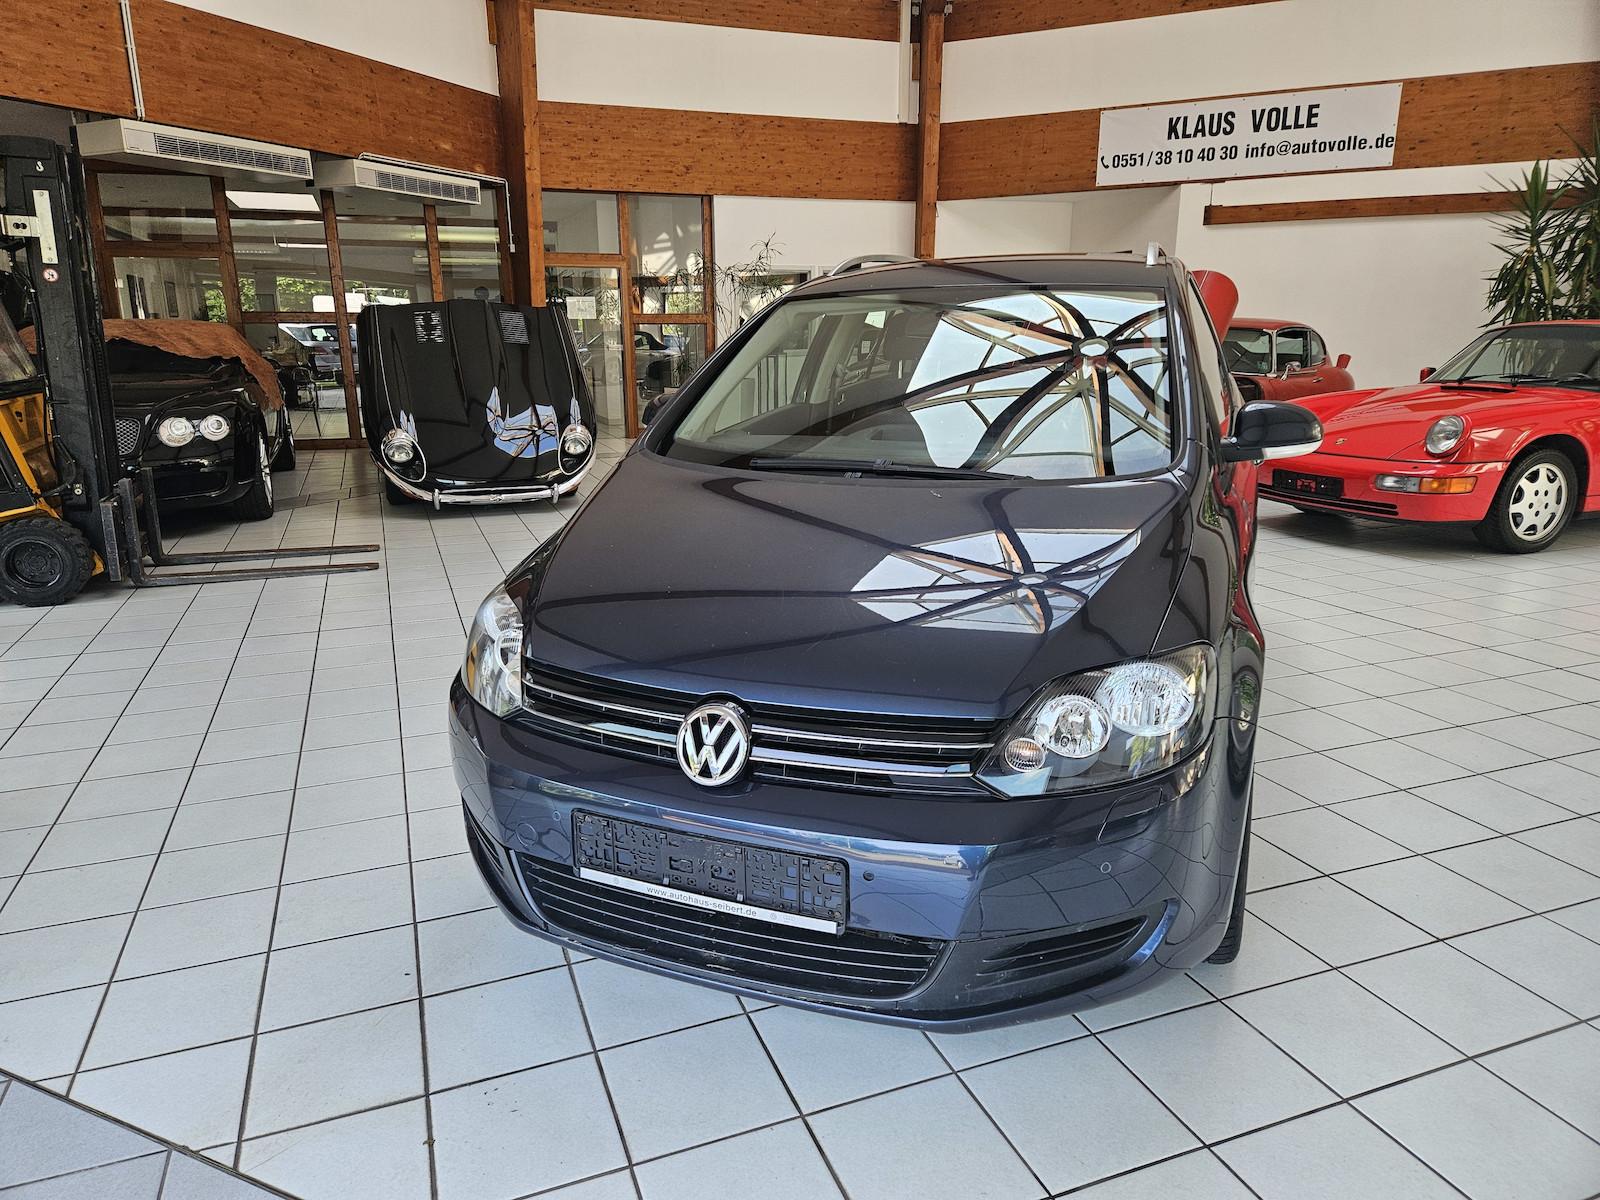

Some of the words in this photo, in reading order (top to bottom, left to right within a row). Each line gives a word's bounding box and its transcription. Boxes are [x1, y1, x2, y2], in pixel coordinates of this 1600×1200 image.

[1167, 111, 1236, 140] KLAUS
[1251, 104, 1322, 133] VOLLE
[1245, 133, 1396, 159] info@autovolle.de
[680, 707, 745, 783] VW
[646, 886, 758, 918] www.autohaus-seibert.de
